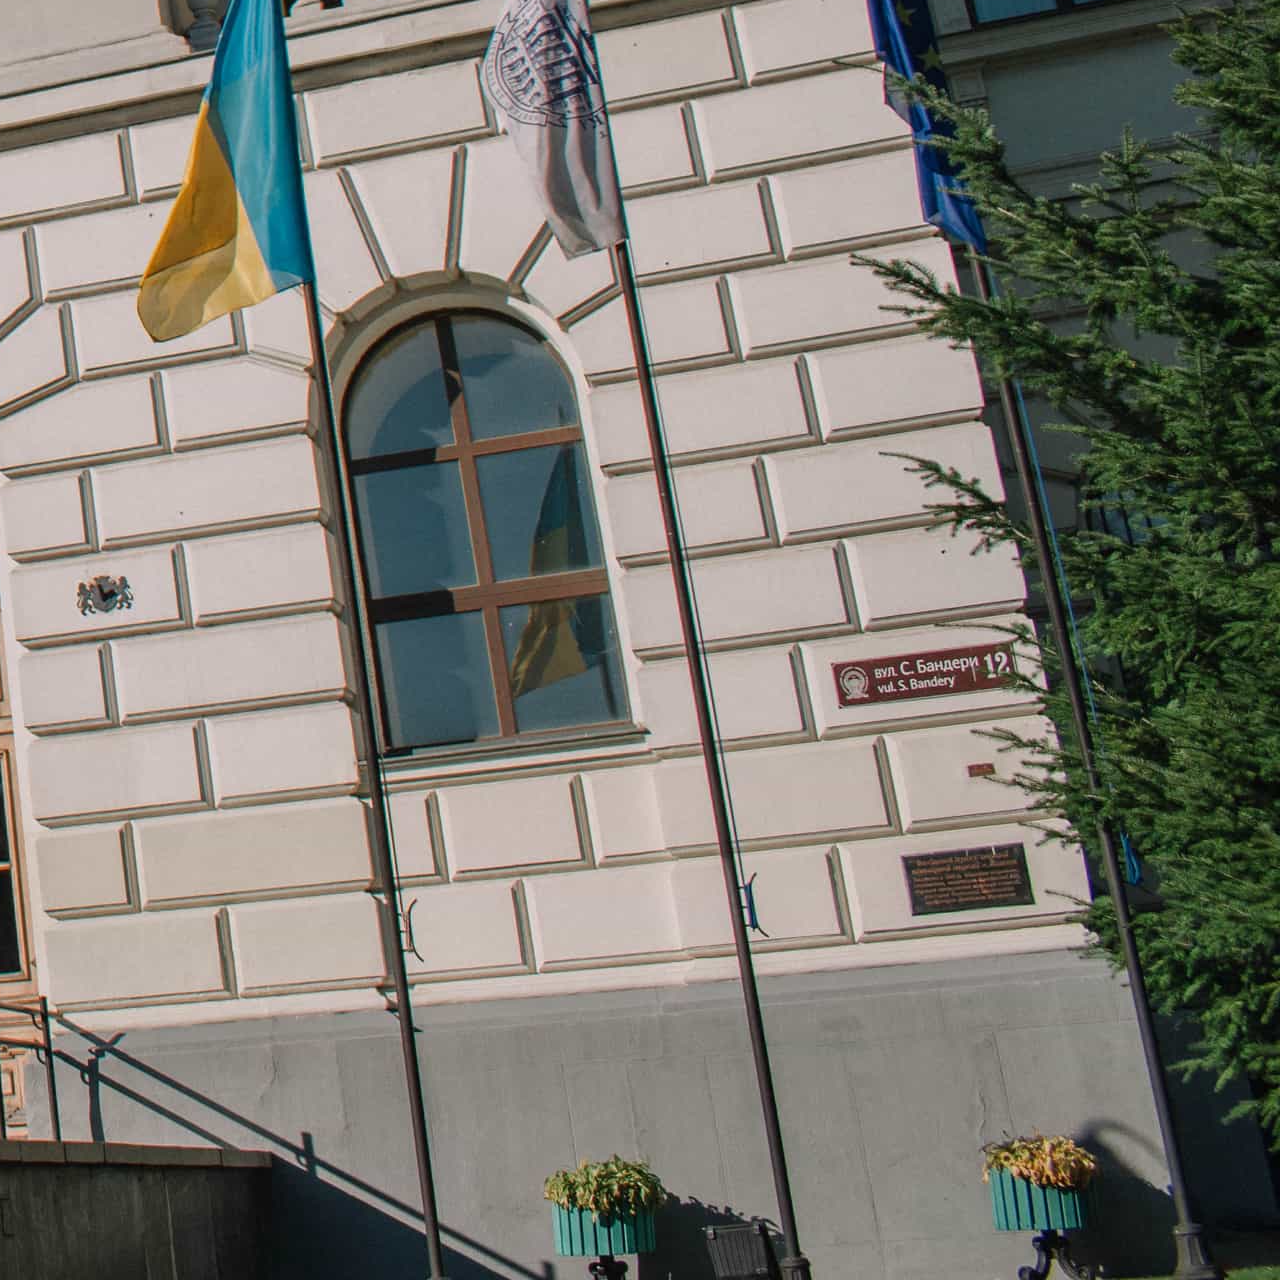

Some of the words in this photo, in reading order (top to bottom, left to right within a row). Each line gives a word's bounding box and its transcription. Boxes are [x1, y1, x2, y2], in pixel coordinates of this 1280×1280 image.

[874, 666, 898, 679] вул.
[900, 661, 914, 676] С.
[916, 655, 980, 674] Бандери
[983, 652, 1010, 679] 12
[877, 680, 897, 693] vul.
[898, 679, 909, 691] S.
[909, 675, 956, 690] Bandery
